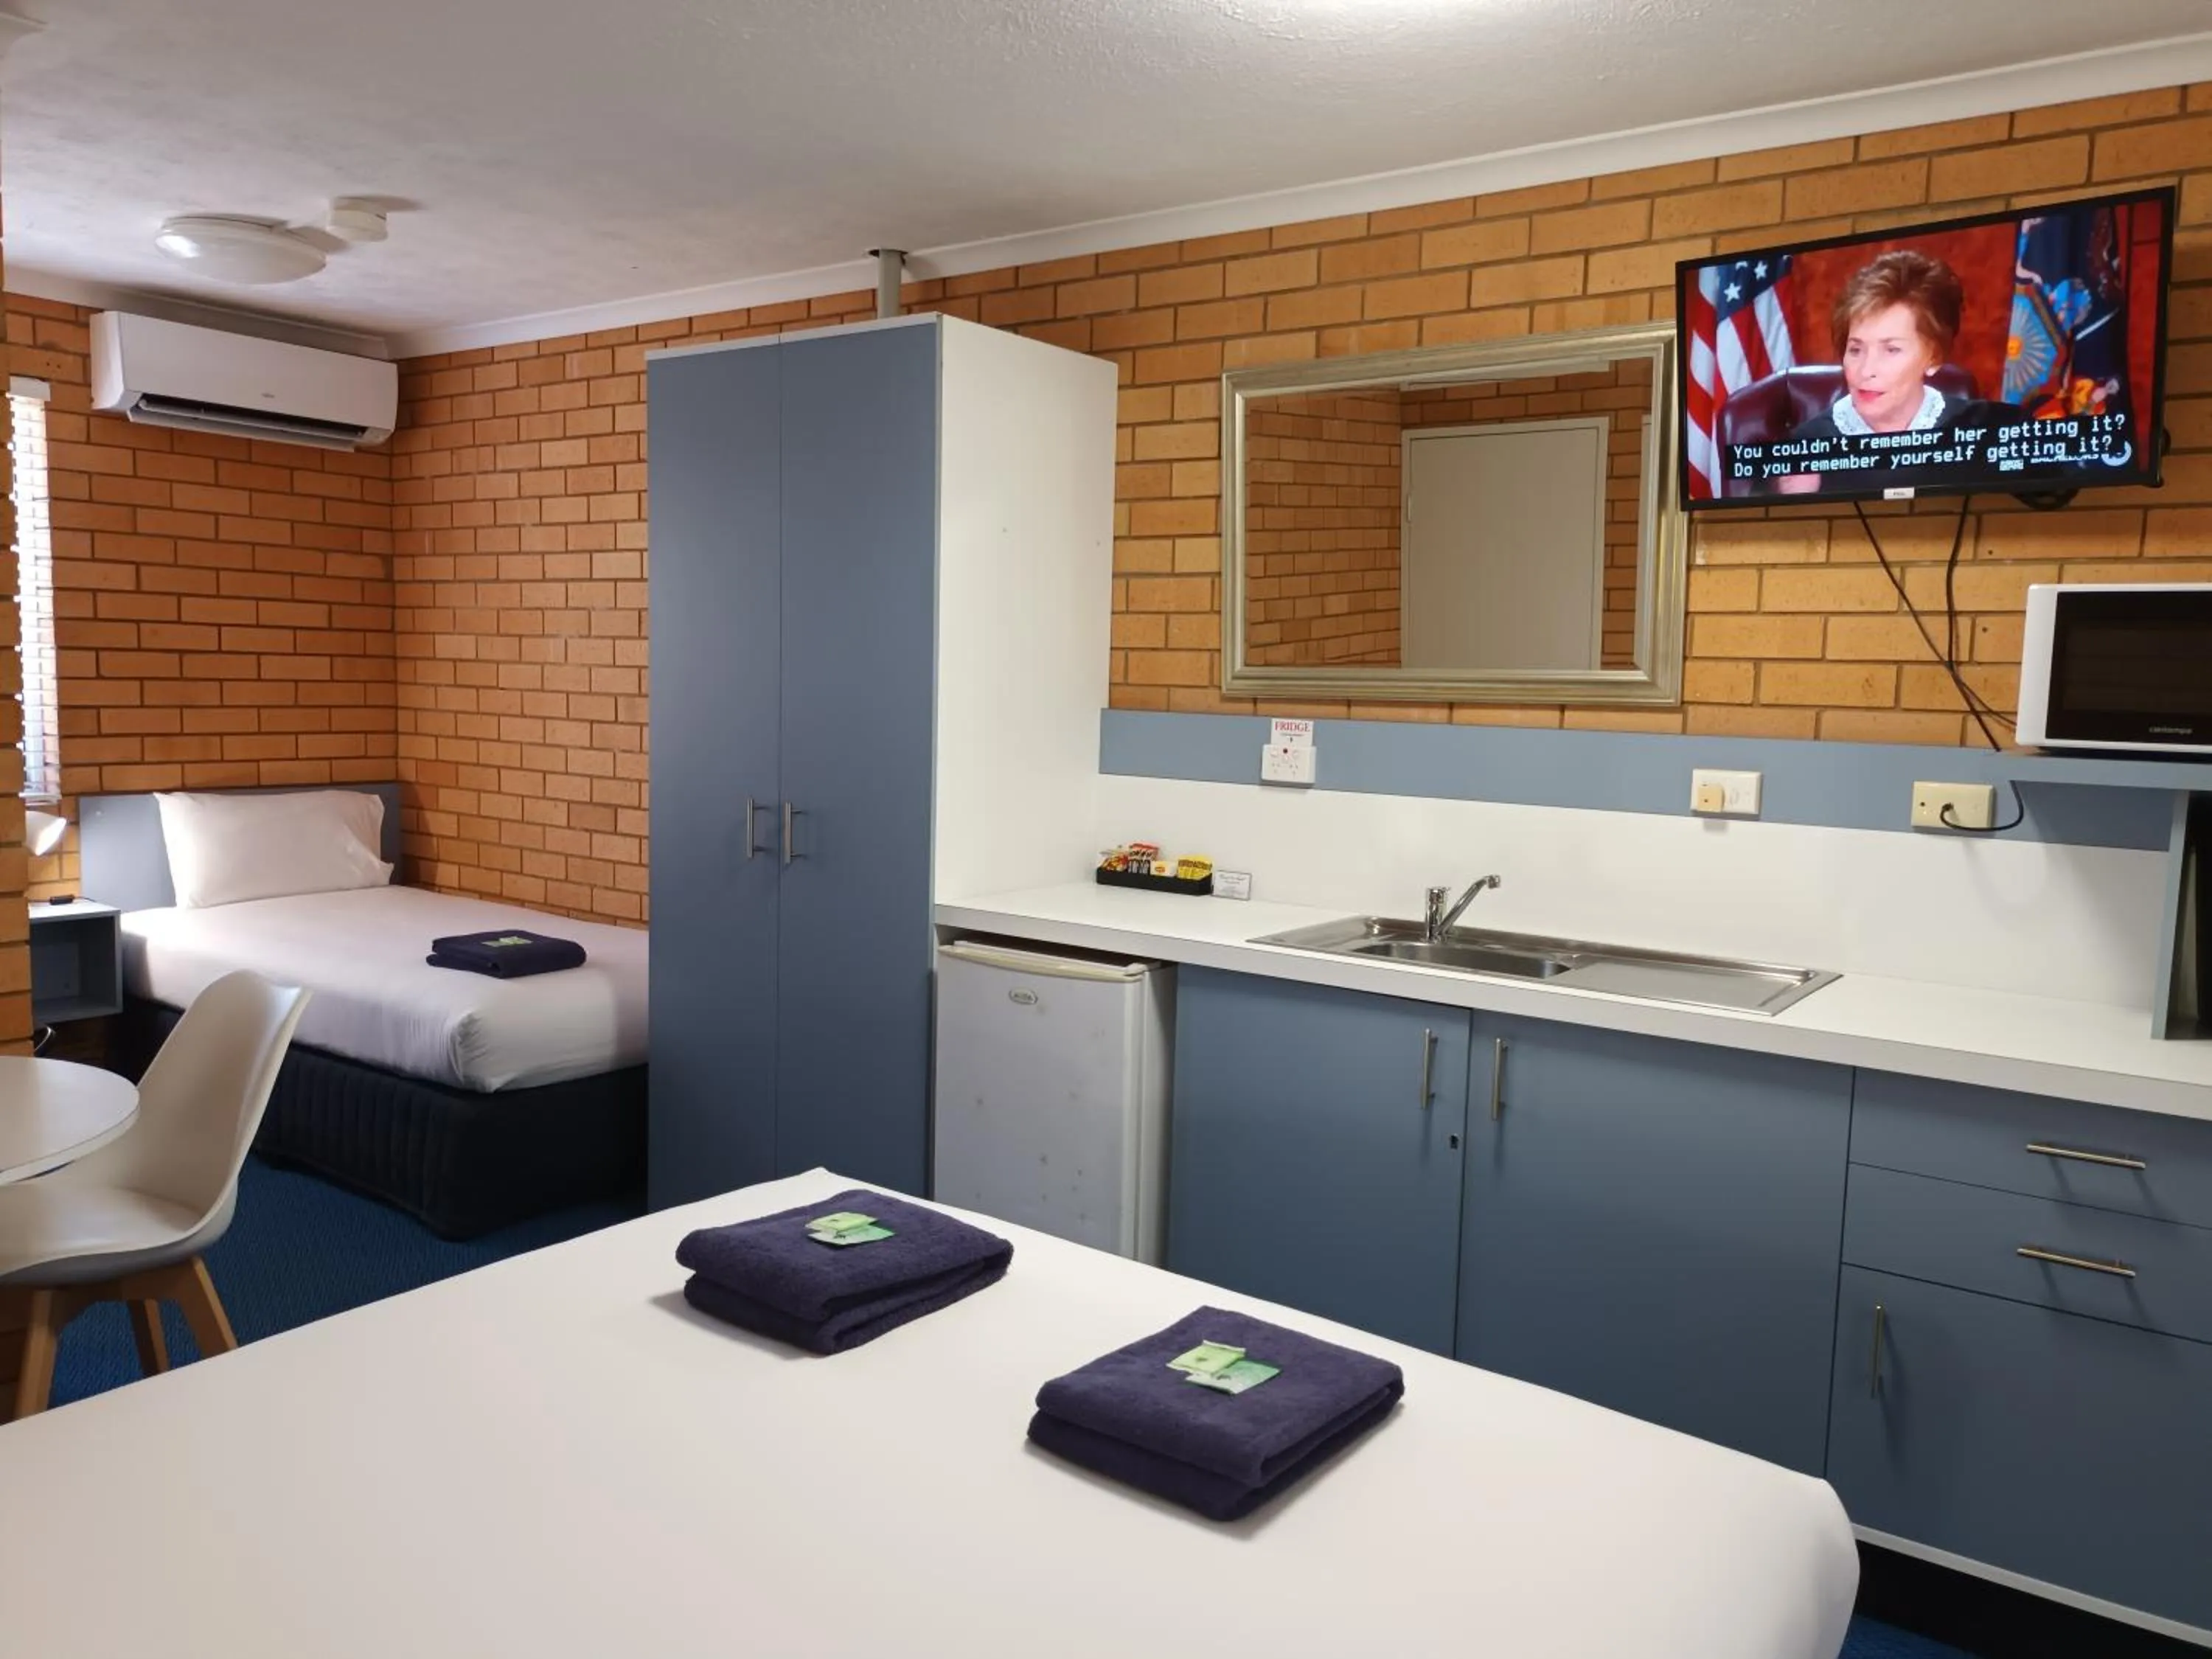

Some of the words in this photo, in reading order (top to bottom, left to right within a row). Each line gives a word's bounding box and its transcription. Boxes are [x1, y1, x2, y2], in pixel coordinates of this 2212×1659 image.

[1733, 445, 1762, 459] You
[1772, 437, 1848, 456] couldn't
[1860, 431, 1943, 450] remember
[1955, 428, 1986, 442] her
[1999, 420, 2079, 442] getting
[2092, 414, 2125, 432] it?
[1734, 462, 1753, 477] Do
[1762, 462, 1791, 479] you
[1800, 454, 1879, 473] remember
[1891, 445, 1975, 470] yourself
[1987, 440, 2066, 463] getting
[2079, 435, 2112, 453] it?
[1274, 722, 1310, 732] FRIDGE
